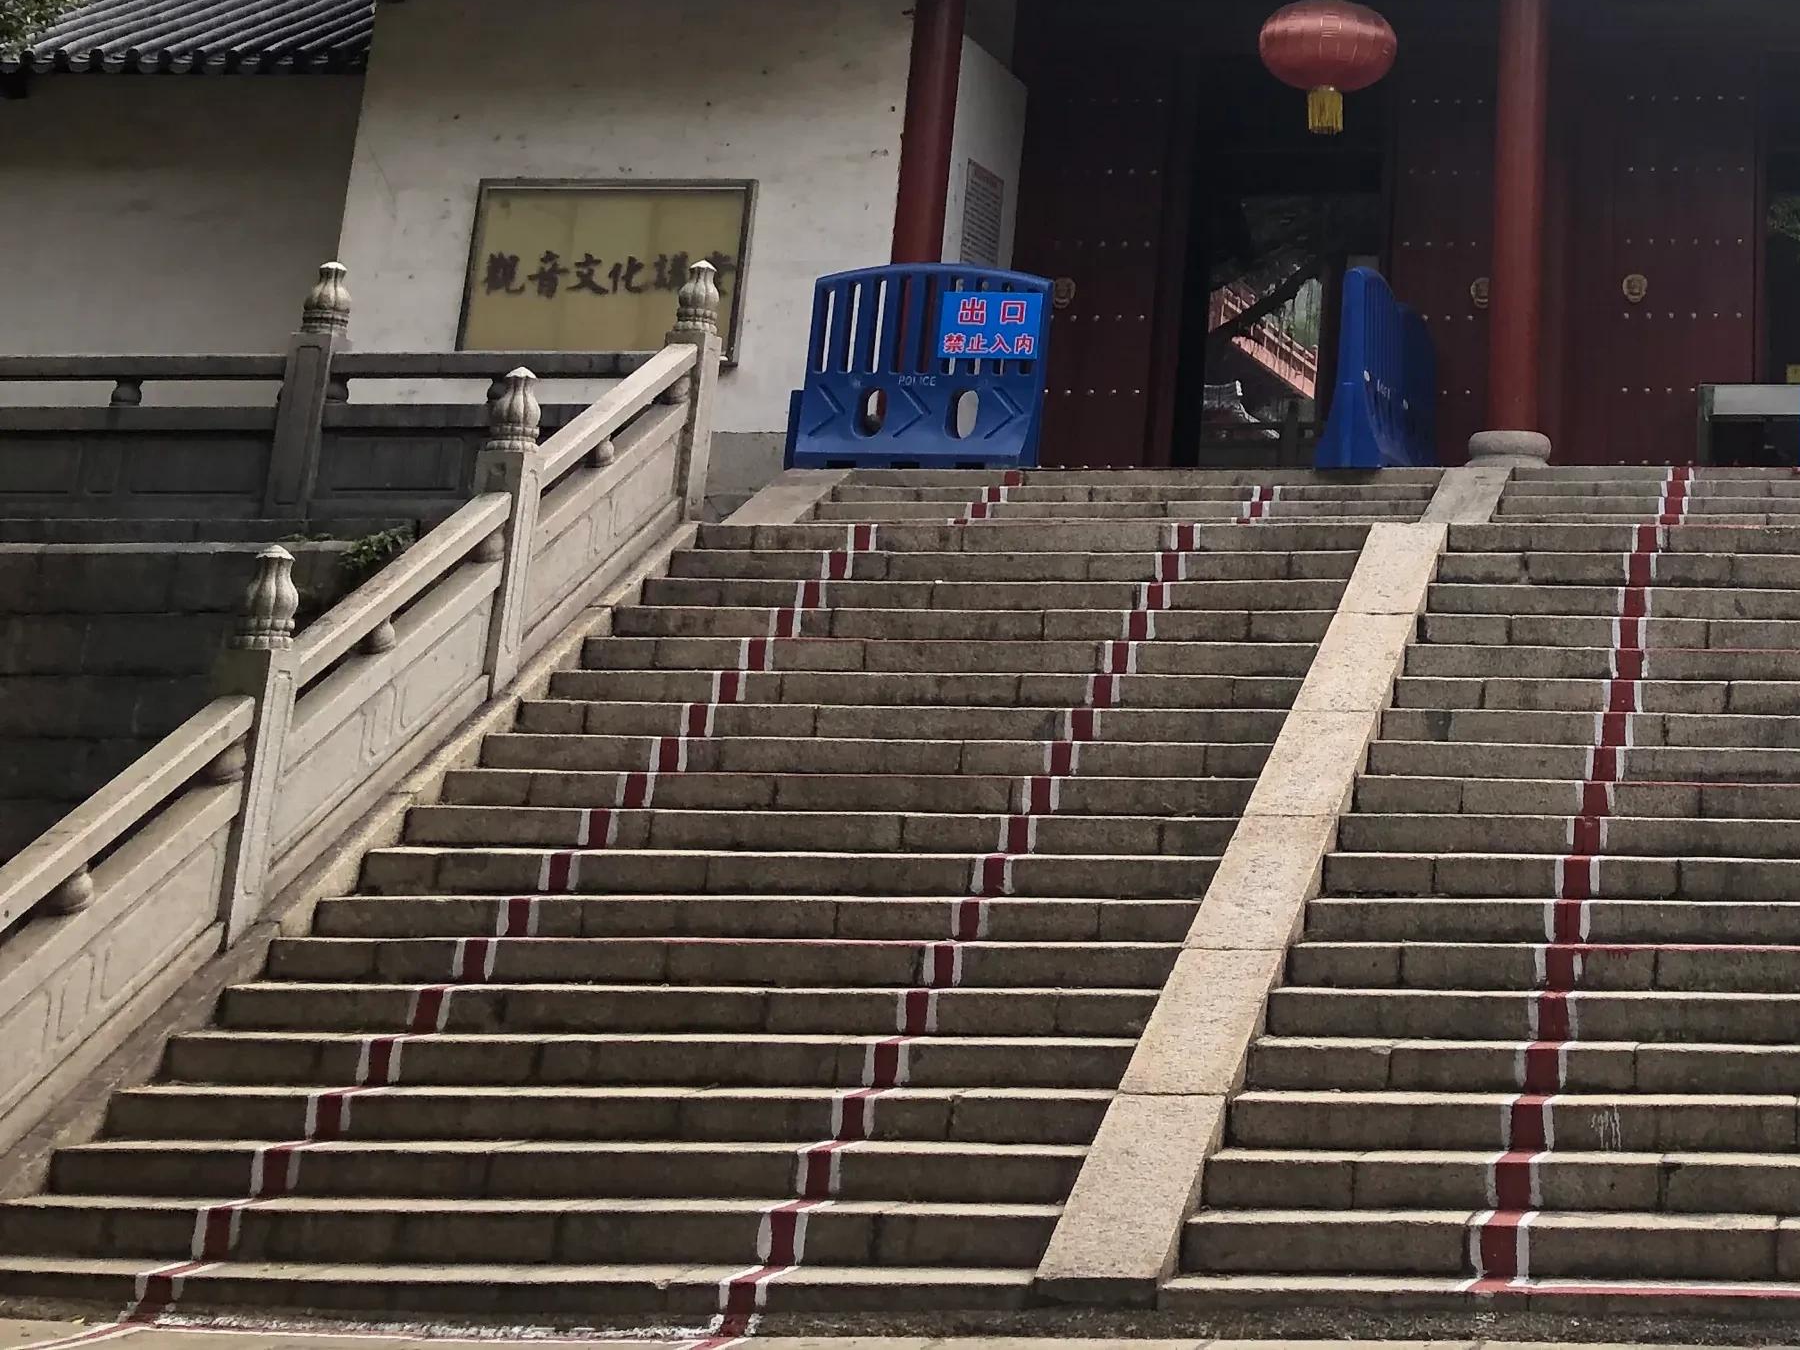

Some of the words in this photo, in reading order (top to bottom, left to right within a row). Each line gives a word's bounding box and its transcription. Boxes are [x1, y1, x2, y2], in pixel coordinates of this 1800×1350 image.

[958, 297, 1027, 325] 出口
[943, 333, 1034, 354] 禁止入内
